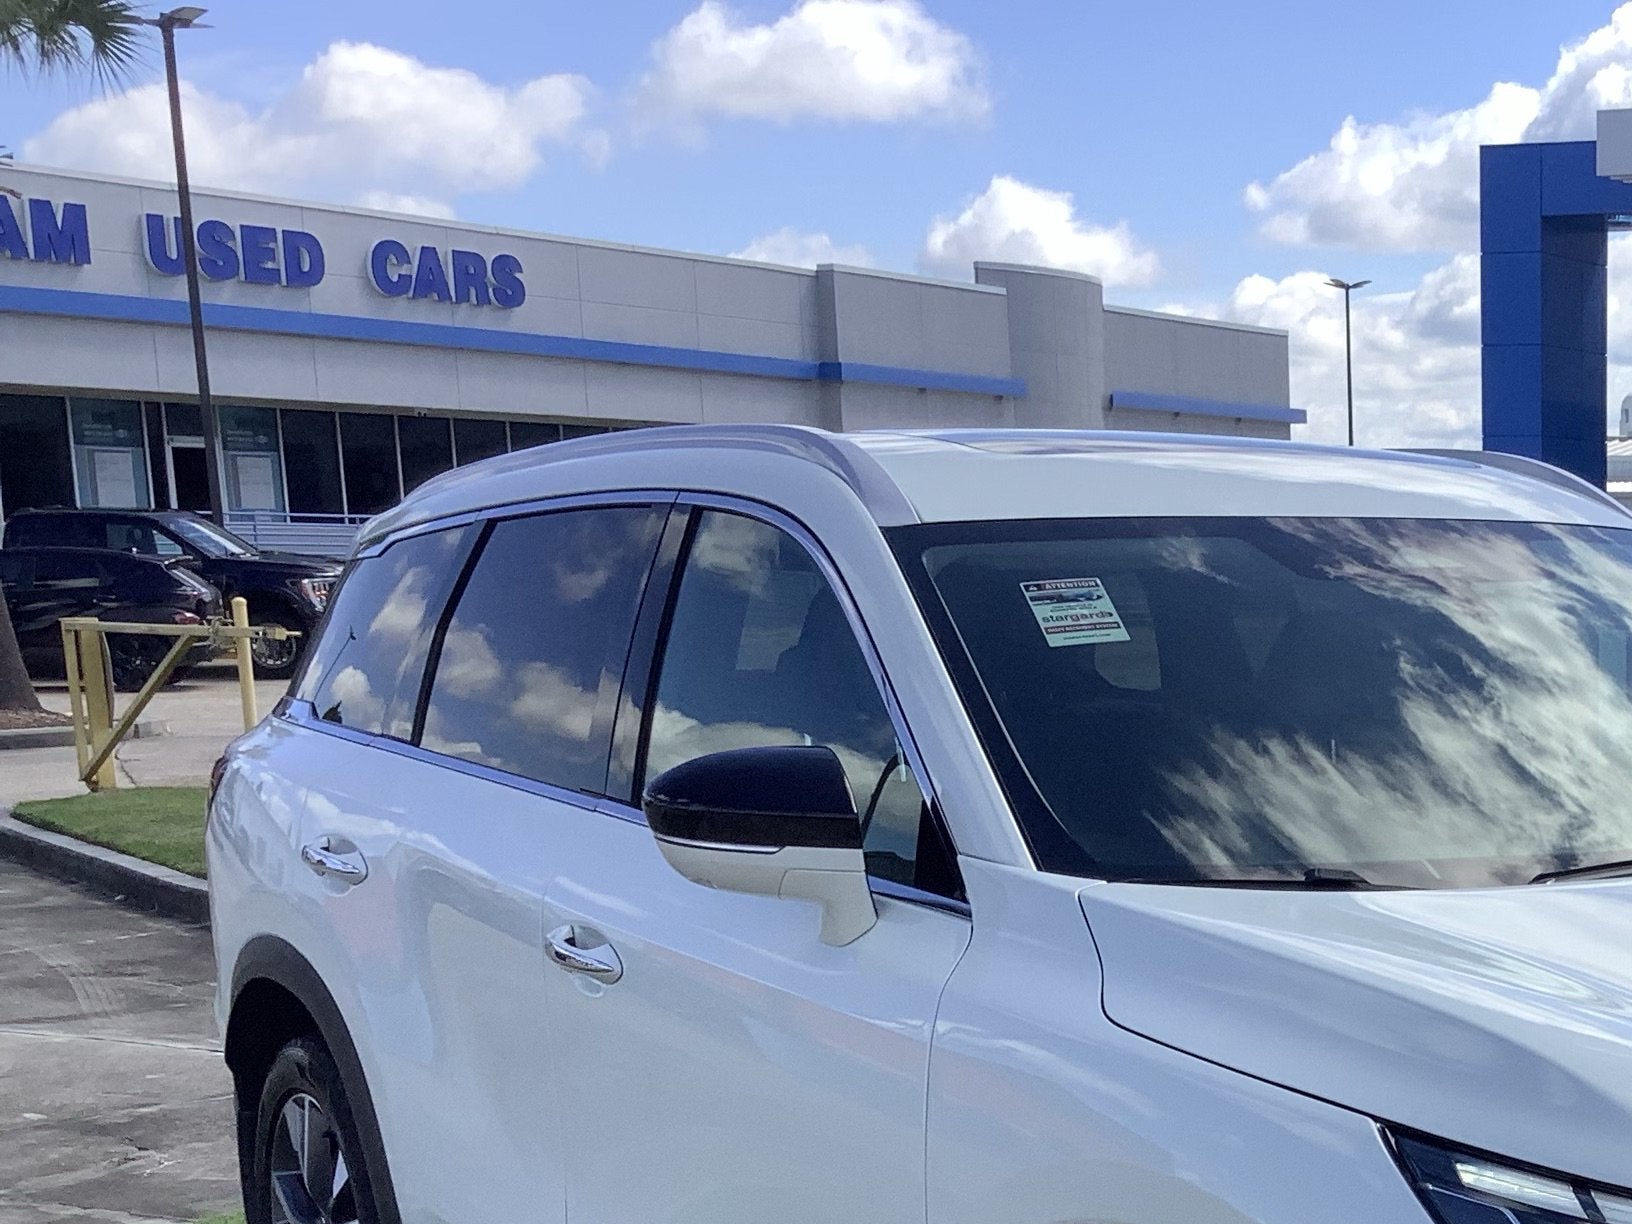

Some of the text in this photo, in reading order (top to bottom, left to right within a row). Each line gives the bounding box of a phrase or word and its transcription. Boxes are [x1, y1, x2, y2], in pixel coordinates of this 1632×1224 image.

[145, 212, 325, 288] USED
[369, 239, 526, 309] CARS
[1044, 580, 1096, 590] ATTENTION
